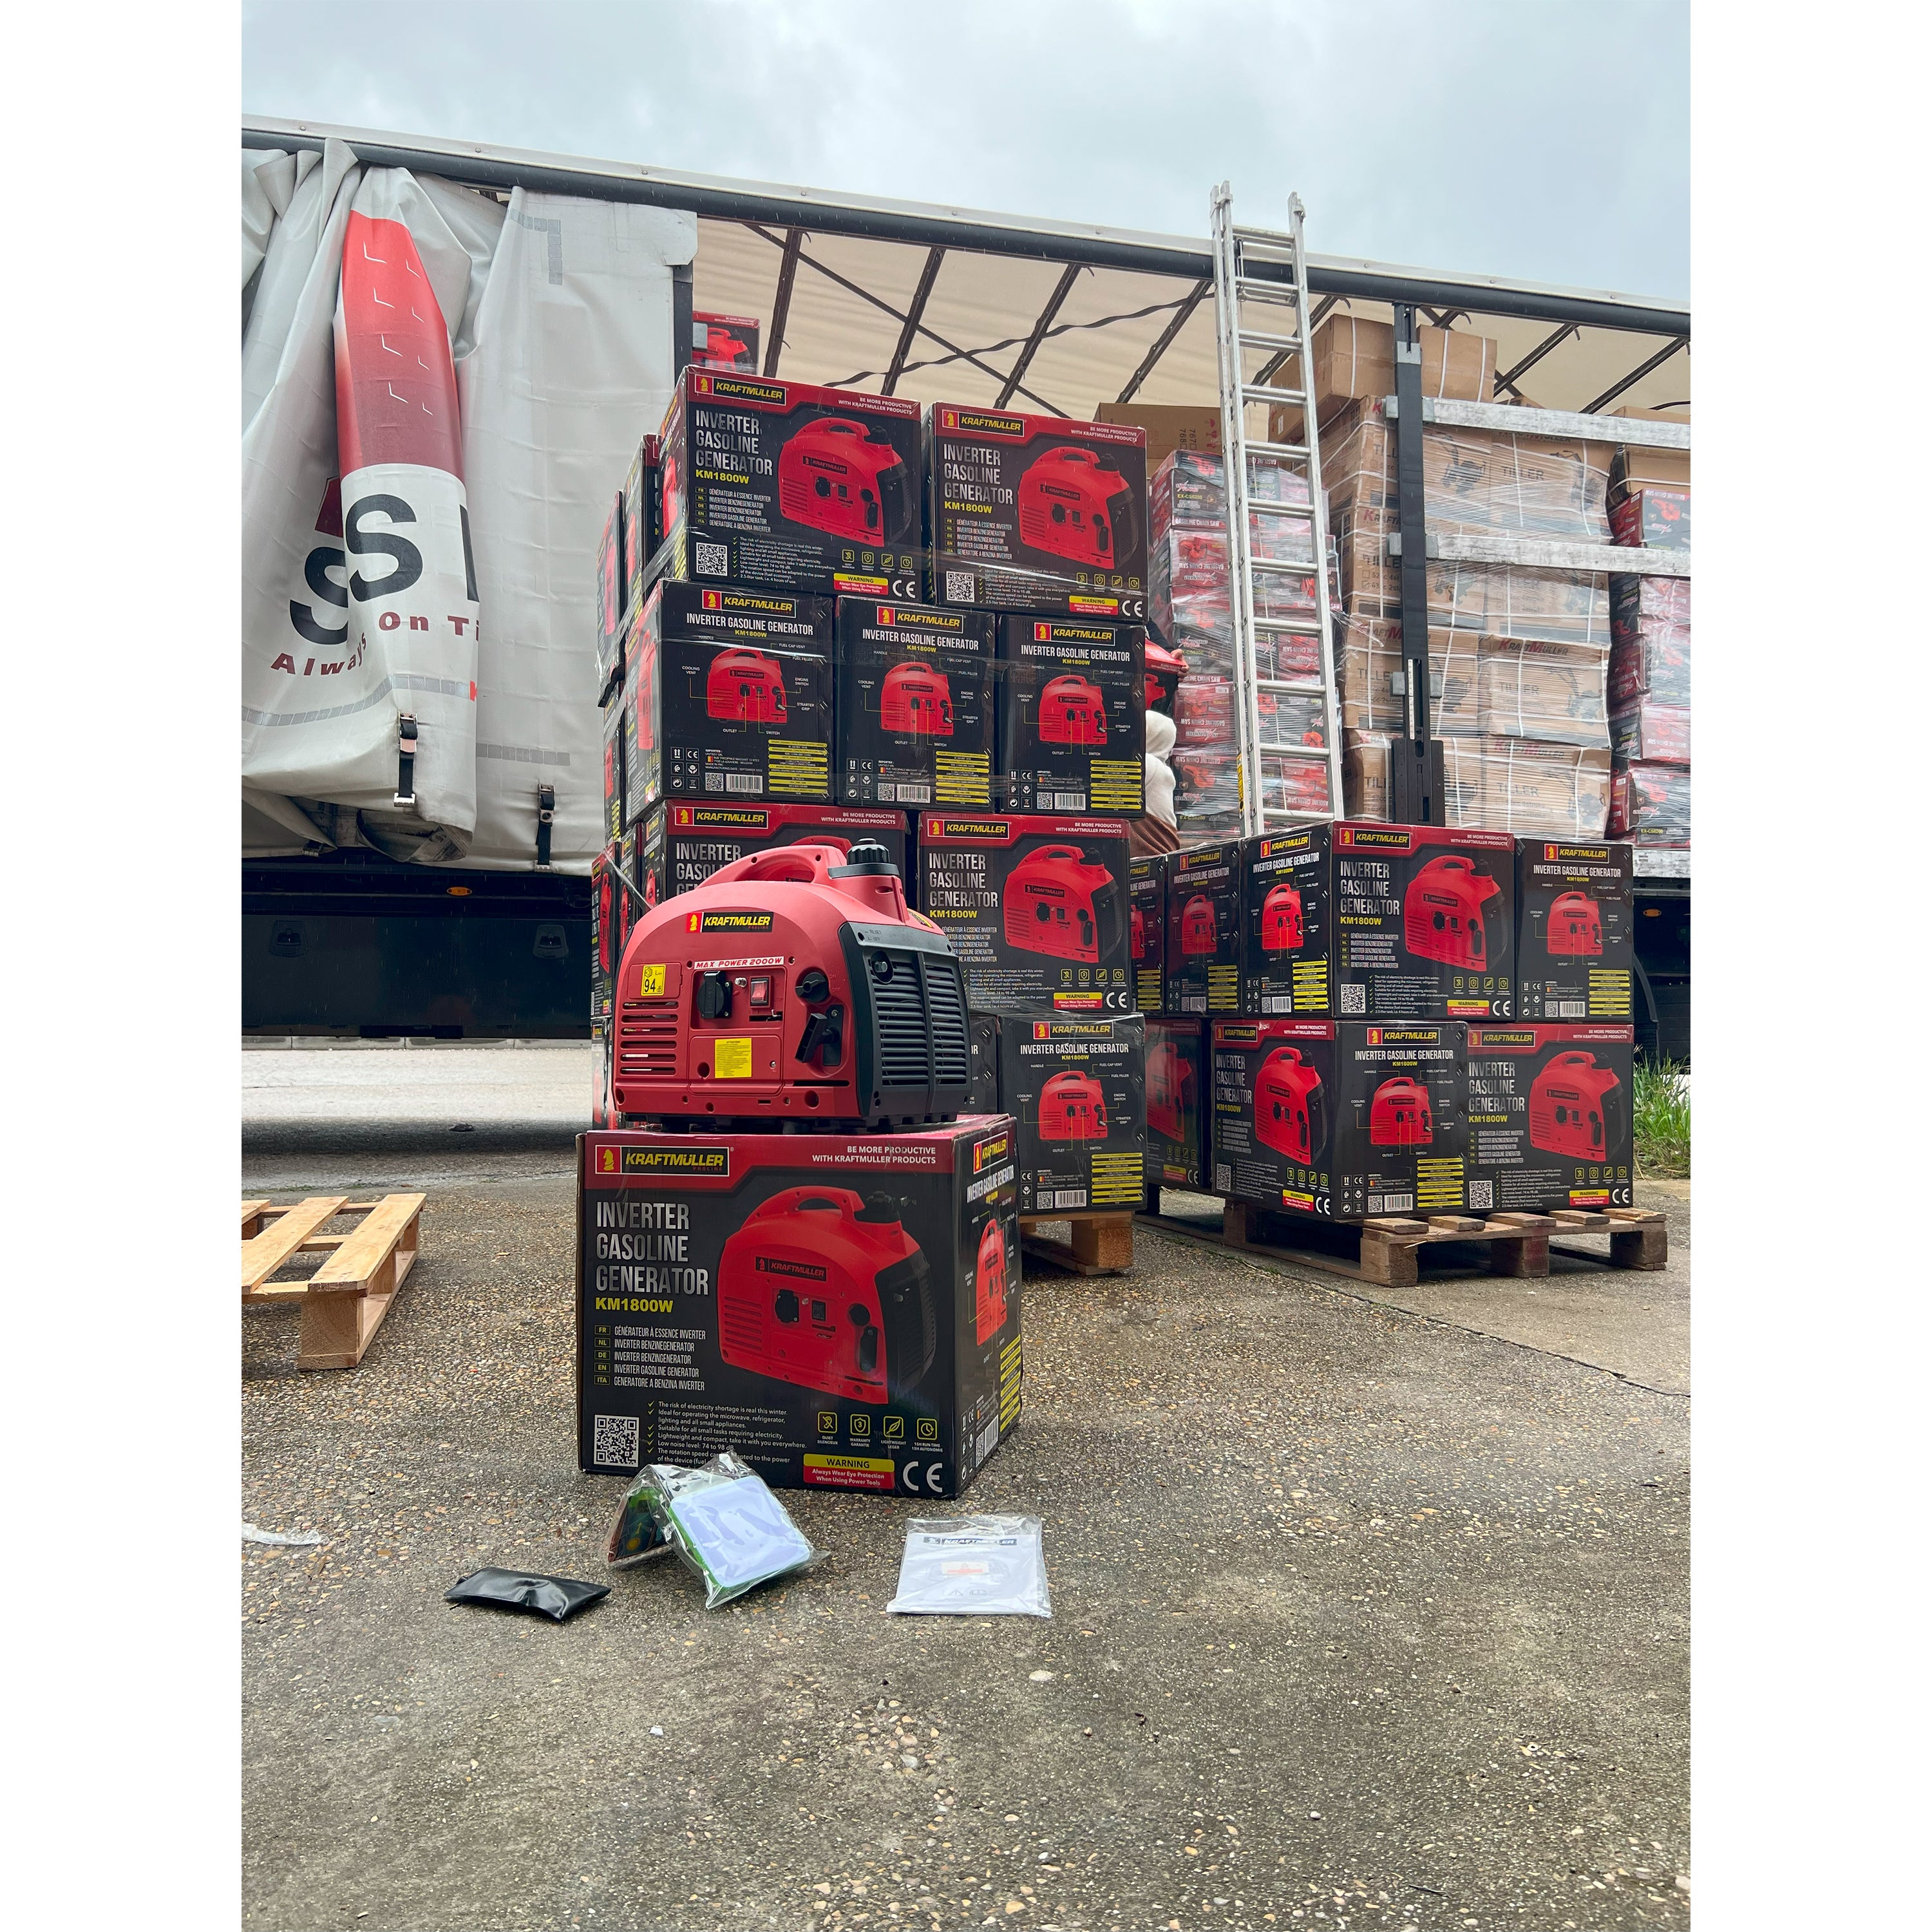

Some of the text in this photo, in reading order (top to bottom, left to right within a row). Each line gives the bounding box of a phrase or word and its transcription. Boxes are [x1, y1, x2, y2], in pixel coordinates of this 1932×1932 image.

[696, 410, 761, 435] INVERTER
[696, 430, 759, 455] GASOLINE
[696, 450, 772, 476] GENERATOR
[943, 444, 1001, 466] INVERTER
[696, 469, 750, 484] KM1800W
[944, 464, 1000, 484] GASOLINE
[945, 482, 1013, 504] GENERATOR
[687, 613, 813, 635] INVERTER GASOLINE GENERATOR
[862, 629, 979, 650] INVERTER GASOLINE GENERATOR
[270, 632, 366, 676] Always
[676, 842, 741, 861] INVERTER
[929, 853, 986, 869] INVERTER
[1340, 860, 1389, 879] INVERTER
[1533, 865, 1621, 878] INVERTER GASOLINE GENERATOR
[929, 871, 985, 889] GASOLINE
[1340, 880, 1389, 896] GASOLINE
[929, 891, 998, 907] GENERATOR
[1340, 898, 1400, 916] GENERATOR
[929, 910, 977, 918] KM1800W
[645, 979, 656, 992] 94
[1021, 1043, 1128, 1055] INVERTER GASOLINE GENERATOR
[1355, 1050, 1453, 1061] INVERTER GASOLINE GENERATOR
[1469, 1062, 1515, 1076] INVERTER
[1469, 1079, 1515, 1094] GASOLINE
[1469, 1097, 1525, 1112] GENERATOR
[967, 1181, 983, 1203] INVERTER
[983, 1175, 998, 1195] GASOLINE
[998, 1164, 1014, 1187] GENERATOR
[597, 1202, 689, 1229] INVERTER
[596, 1233, 688, 1262] GASOLINE
[596, 1265, 708, 1295] GENERATOR
[596, 1298, 673, 1312] KM1800W
[614, 1325, 649, 1337] GÉNÉRATEUR
[650, 1327, 654, 1337] À
[655, 1329, 678, 1338] ESSENCE
[680, 1329, 706, 1340] INVERTER
[615, 1339, 639, 1349] INVERTER
[641, 1340, 695, 1352] BENZINEGENERATOR
[614, 1352, 639, 1361] INVERTER
[641, 1352, 691, 1364] BENZINGENERATOR
[614, 1364, 639, 1374] INVERTER
[641, 1365, 666, 1376] GASOLINE
[667, 1367, 699, 1378] GENERATOR
[614, 1377, 648, 1387] GENERATORE
[650, 1379, 653, 1387] A
[655, 1379, 677, 1389] BENZINA
[679, 1381, 705, 1390] INVERTER
[755, 1431, 783, 1439] electricity.
[827, 1459, 869, 1468] WARNING
